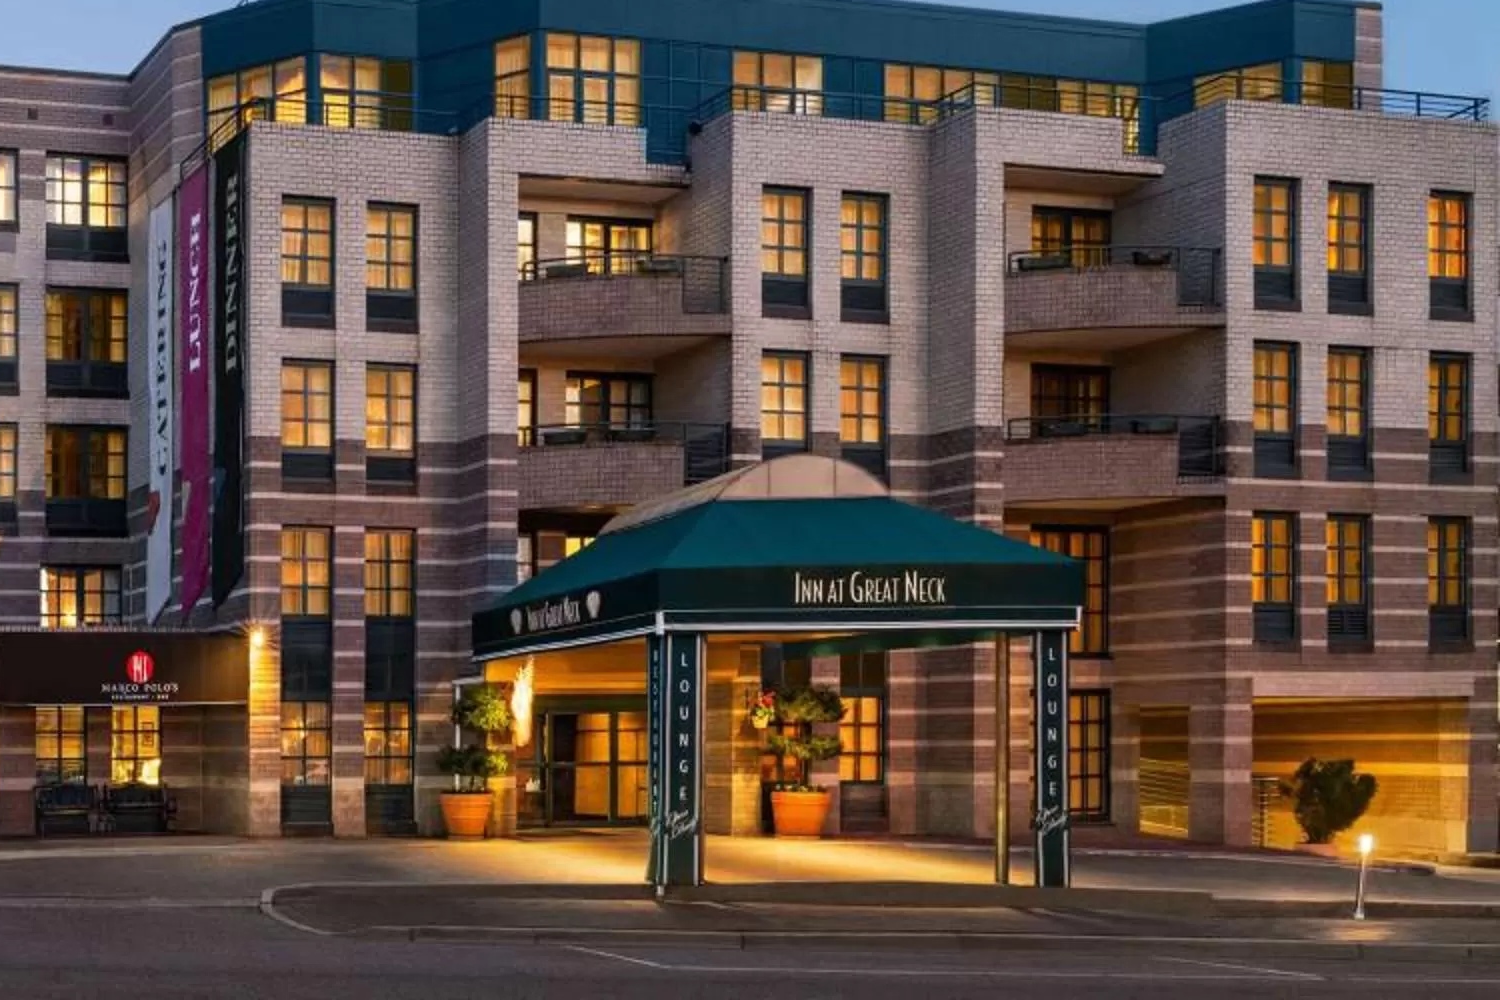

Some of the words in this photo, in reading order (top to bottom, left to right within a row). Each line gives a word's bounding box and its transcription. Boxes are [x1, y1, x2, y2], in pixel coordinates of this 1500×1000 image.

[188, 210, 202, 373] LUNCH
[225, 172, 238, 373] DINNER
[155, 240, 168, 476] CATERING
[795, 571, 823, 604] INN
[827, 579, 846, 604] AT
[850, 570, 900, 603] GREAT
[905, 570, 945, 603] NECK
[101, 683, 139, 693] MARCO
[679, 651, 690, 801] LOUNGE
[1046, 647, 1058, 797] LOUNGE
